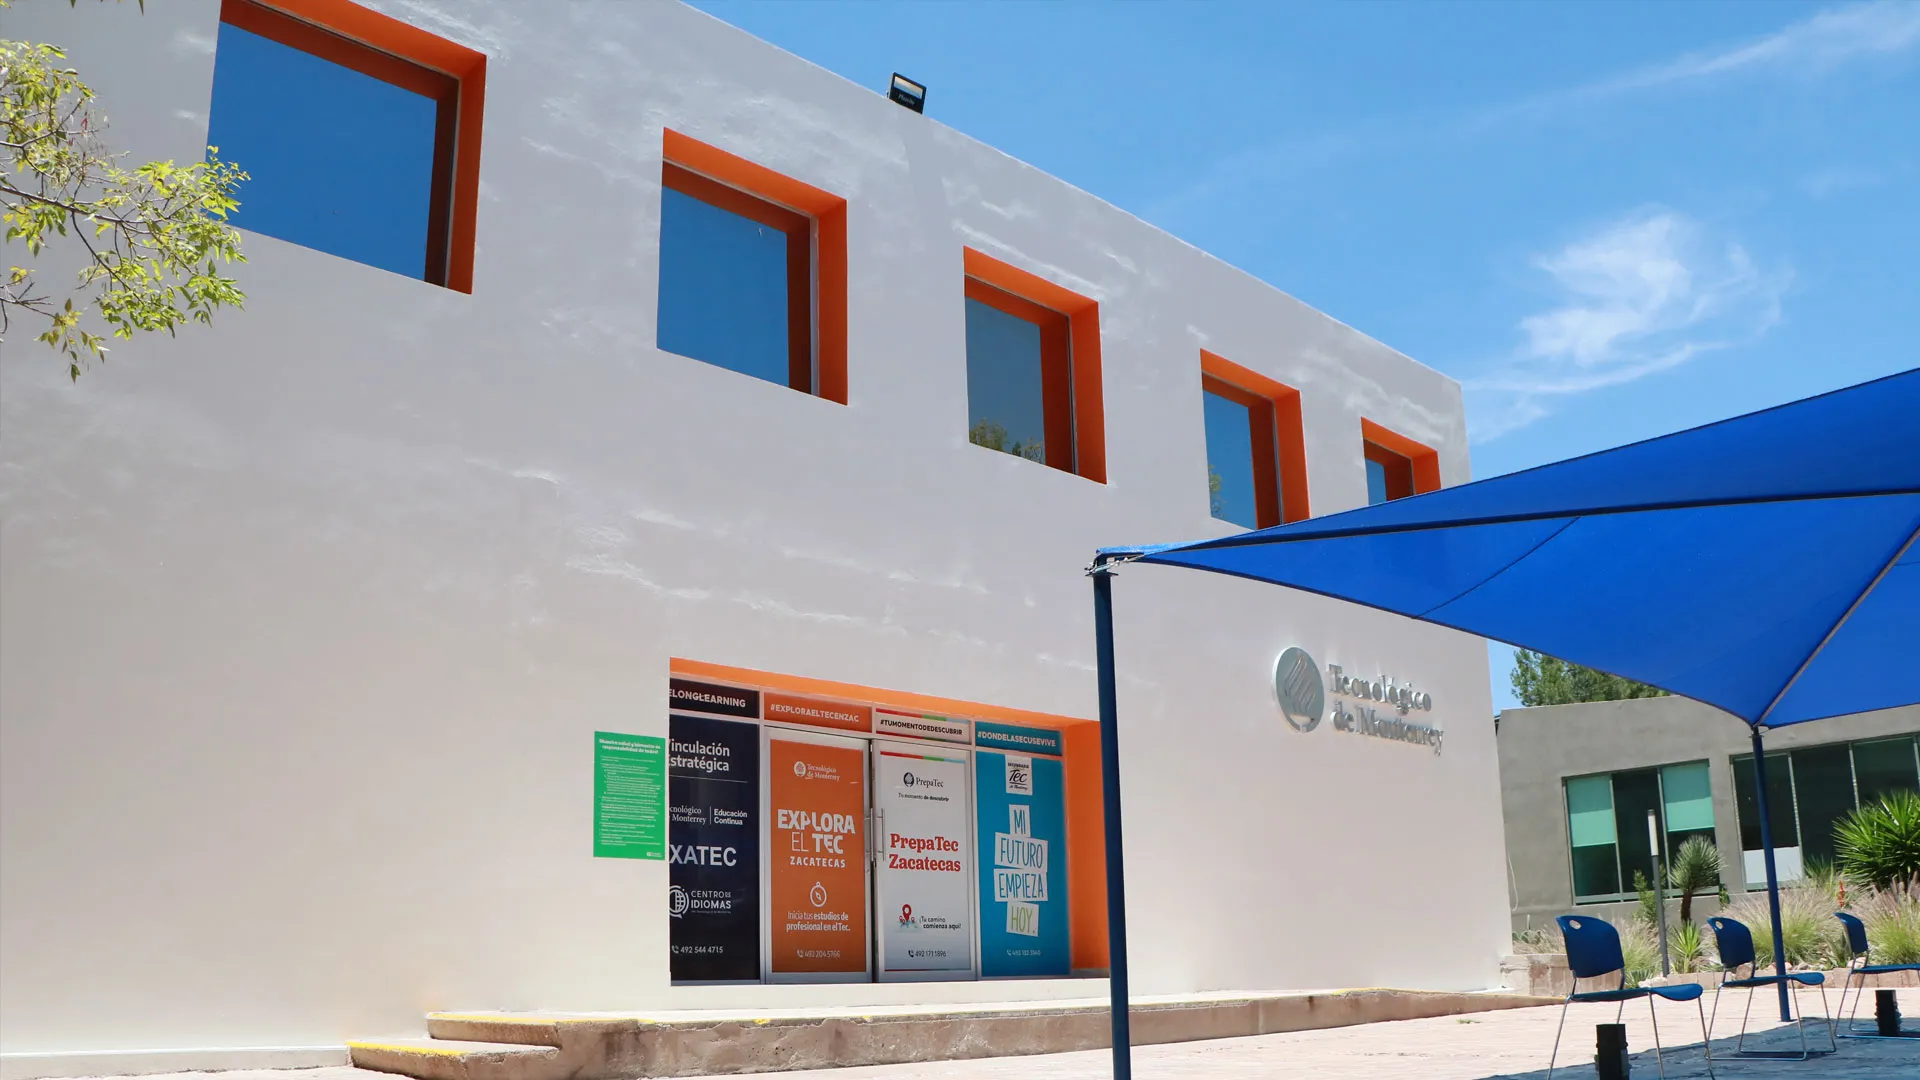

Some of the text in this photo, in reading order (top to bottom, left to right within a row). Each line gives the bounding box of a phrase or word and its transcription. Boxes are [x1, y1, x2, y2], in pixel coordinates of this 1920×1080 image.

[770, 703, 859, 722] #EXPLORAELTECENZAC
[880, 719, 963, 735] #TUMOMENTODEDESCUBRIR
[1330, 700, 1445, 756] de Monterrey
[977, 731, 1057, 747] #DONDELASECUSEVIVE
[916, 777, 944, 788] PrepaTec
[1009, 769, 1027, 783] Tec
[672, 813, 707, 825] Monterrey
[714, 808, 748, 818] Educación
[714, 816, 743, 825] Continua
[777, 809, 856, 834] EXPLORA
[1013, 809, 1027, 835] MI
[791, 831, 844, 854] EL TEC
[890, 833, 959, 853] PrepaTec
[1000, 838, 1043, 869] FUTURO
[790, 856, 846, 868] ZACATECAS
[888, 853, 961, 872] Zacatecas
[999, 873, 1044, 898] EMPIEZA
[691, 890, 724, 898] CENTRO
[691, 899, 732, 909] IDIOMAS
[788, 910, 849, 921] Inicia tus estudios de
[786, 921, 823, 932] profesional
[832, 922, 838, 931] el
[680, 946, 724, 954] 492 544 4715
